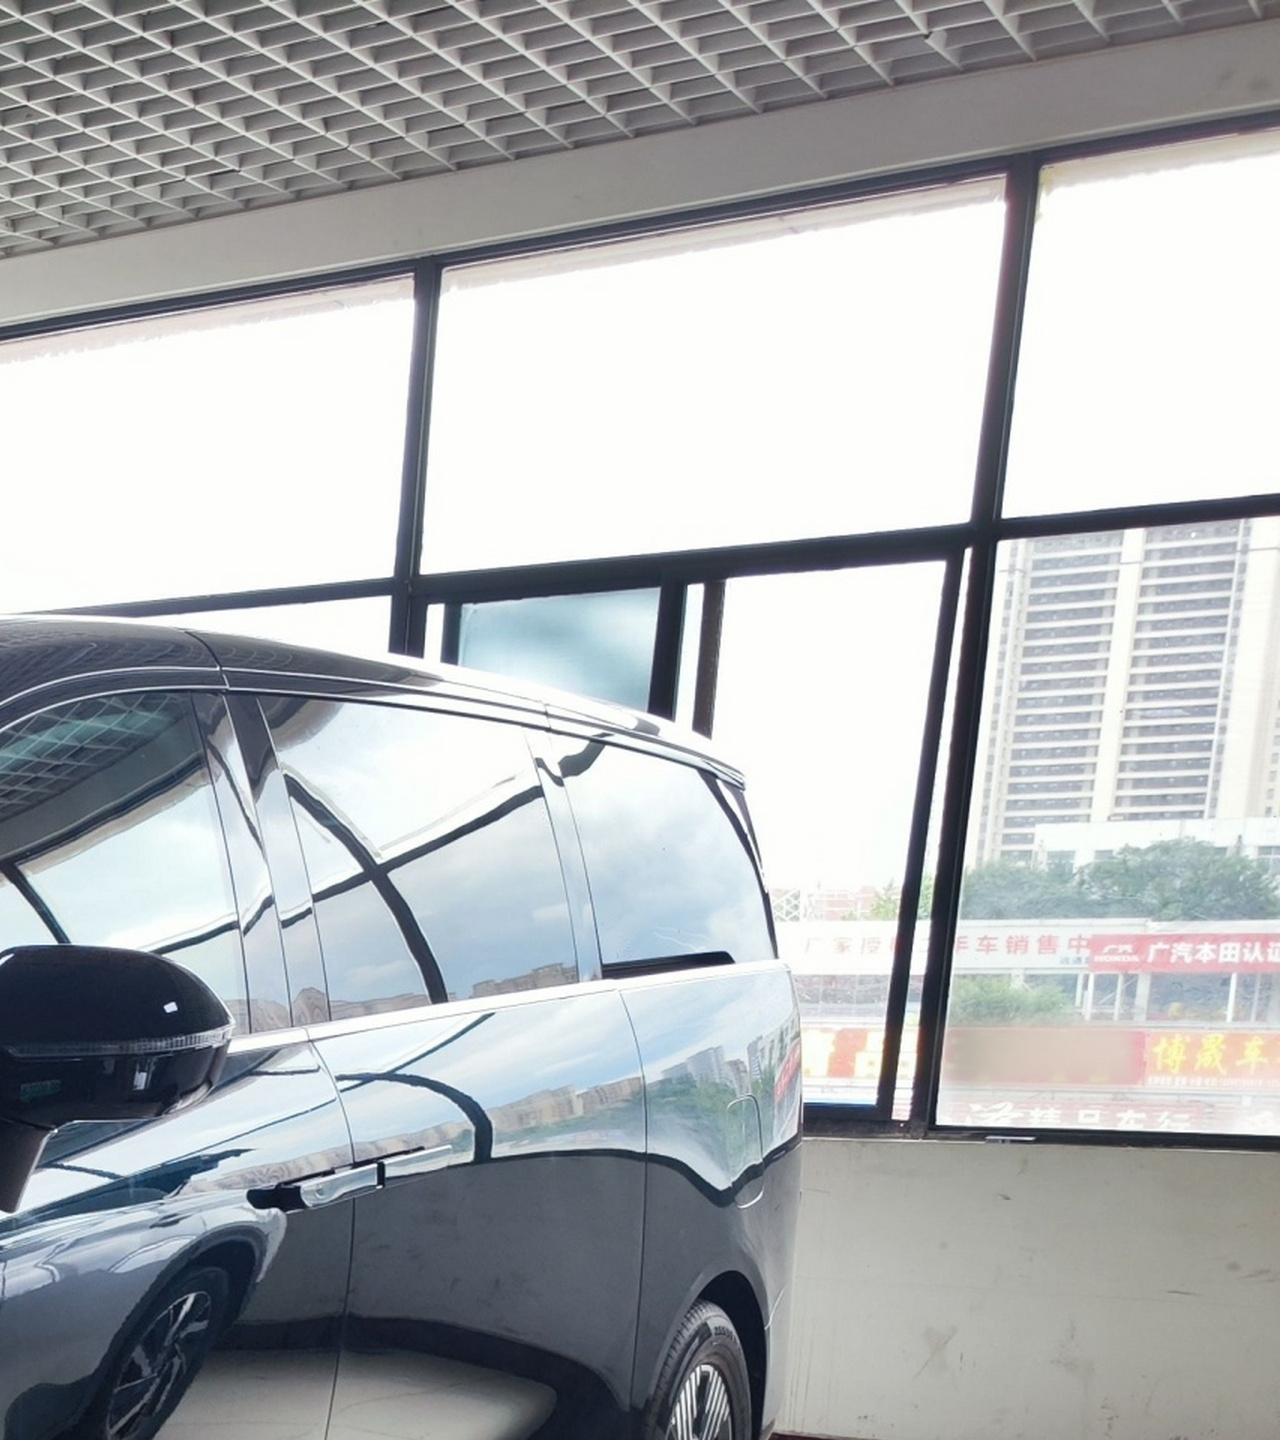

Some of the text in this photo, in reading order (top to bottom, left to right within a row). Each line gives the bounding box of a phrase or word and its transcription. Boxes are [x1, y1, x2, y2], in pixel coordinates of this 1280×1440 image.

[1093, 954, 1140, 963] HONDA
[1147, 941, 1280, 964] 广汽本田认证
[1152, 1033, 1280, 1076] 博晟车
